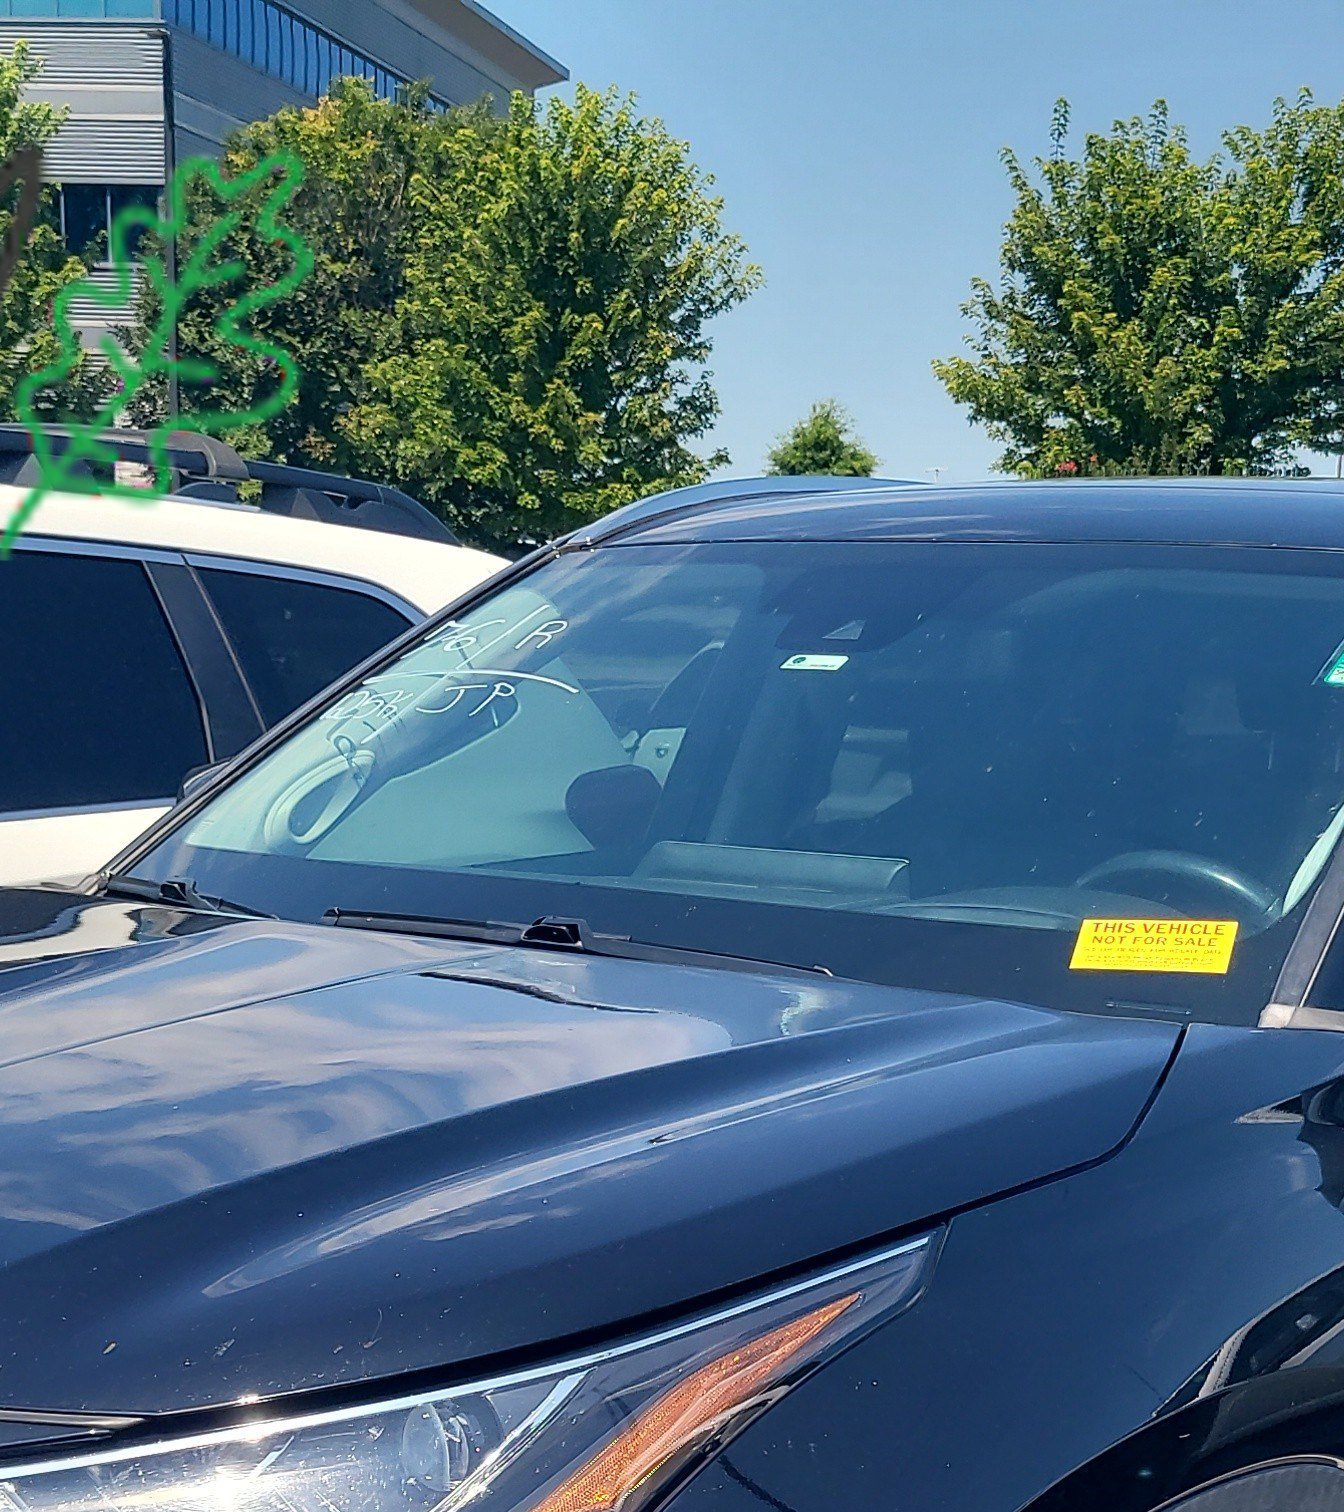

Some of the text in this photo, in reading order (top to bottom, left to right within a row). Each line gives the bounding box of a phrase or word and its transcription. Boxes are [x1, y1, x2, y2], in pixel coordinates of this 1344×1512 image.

[1092, 922, 1227, 936] THIS VEHICLE
[1091, 935, 1219, 948] NOT FOR SALE
